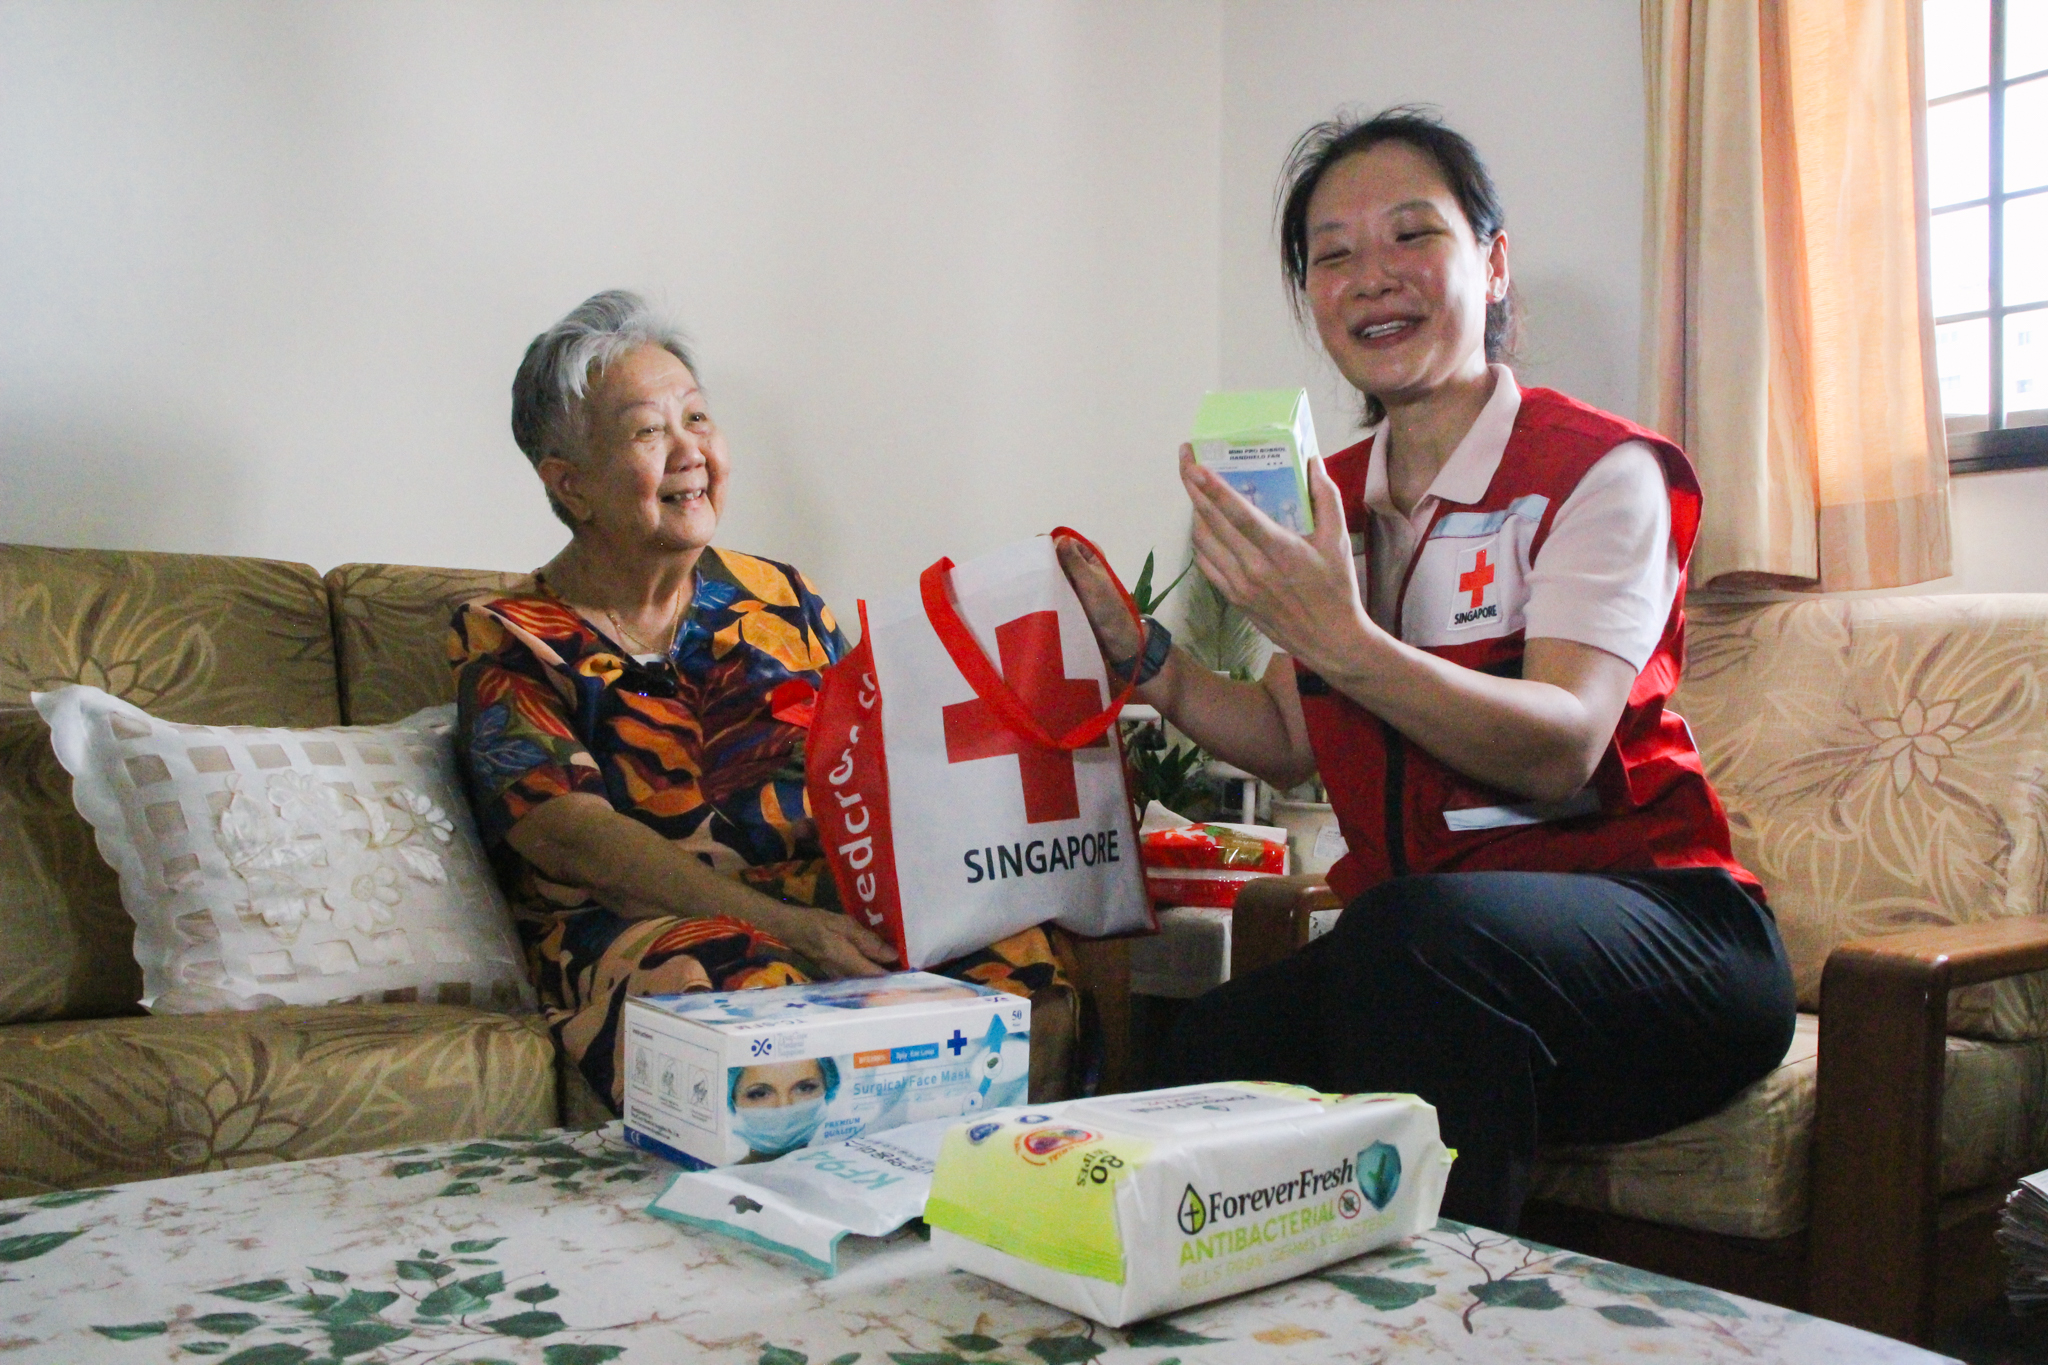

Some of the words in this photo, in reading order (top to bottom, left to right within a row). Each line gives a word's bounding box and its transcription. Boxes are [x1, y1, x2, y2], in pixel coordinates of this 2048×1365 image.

[1454, 604, 1498, 625] SINGAPORE
[963, 829, 1120, 884] SINGAPORE
[1012, 1009, 1022, 1021] 50
[853, 1077, 906, 1097] Surgical
[909, 1074, 937, 1088] Face
[941, 1067, 971, 1083] Mask
[824, 1116, 861, 1129] PREMIUM
[1208, 1157, 1353, 1223] ForeverFresh
[1179, 1200, 1336, 1268] ANTIBACTERIAL
